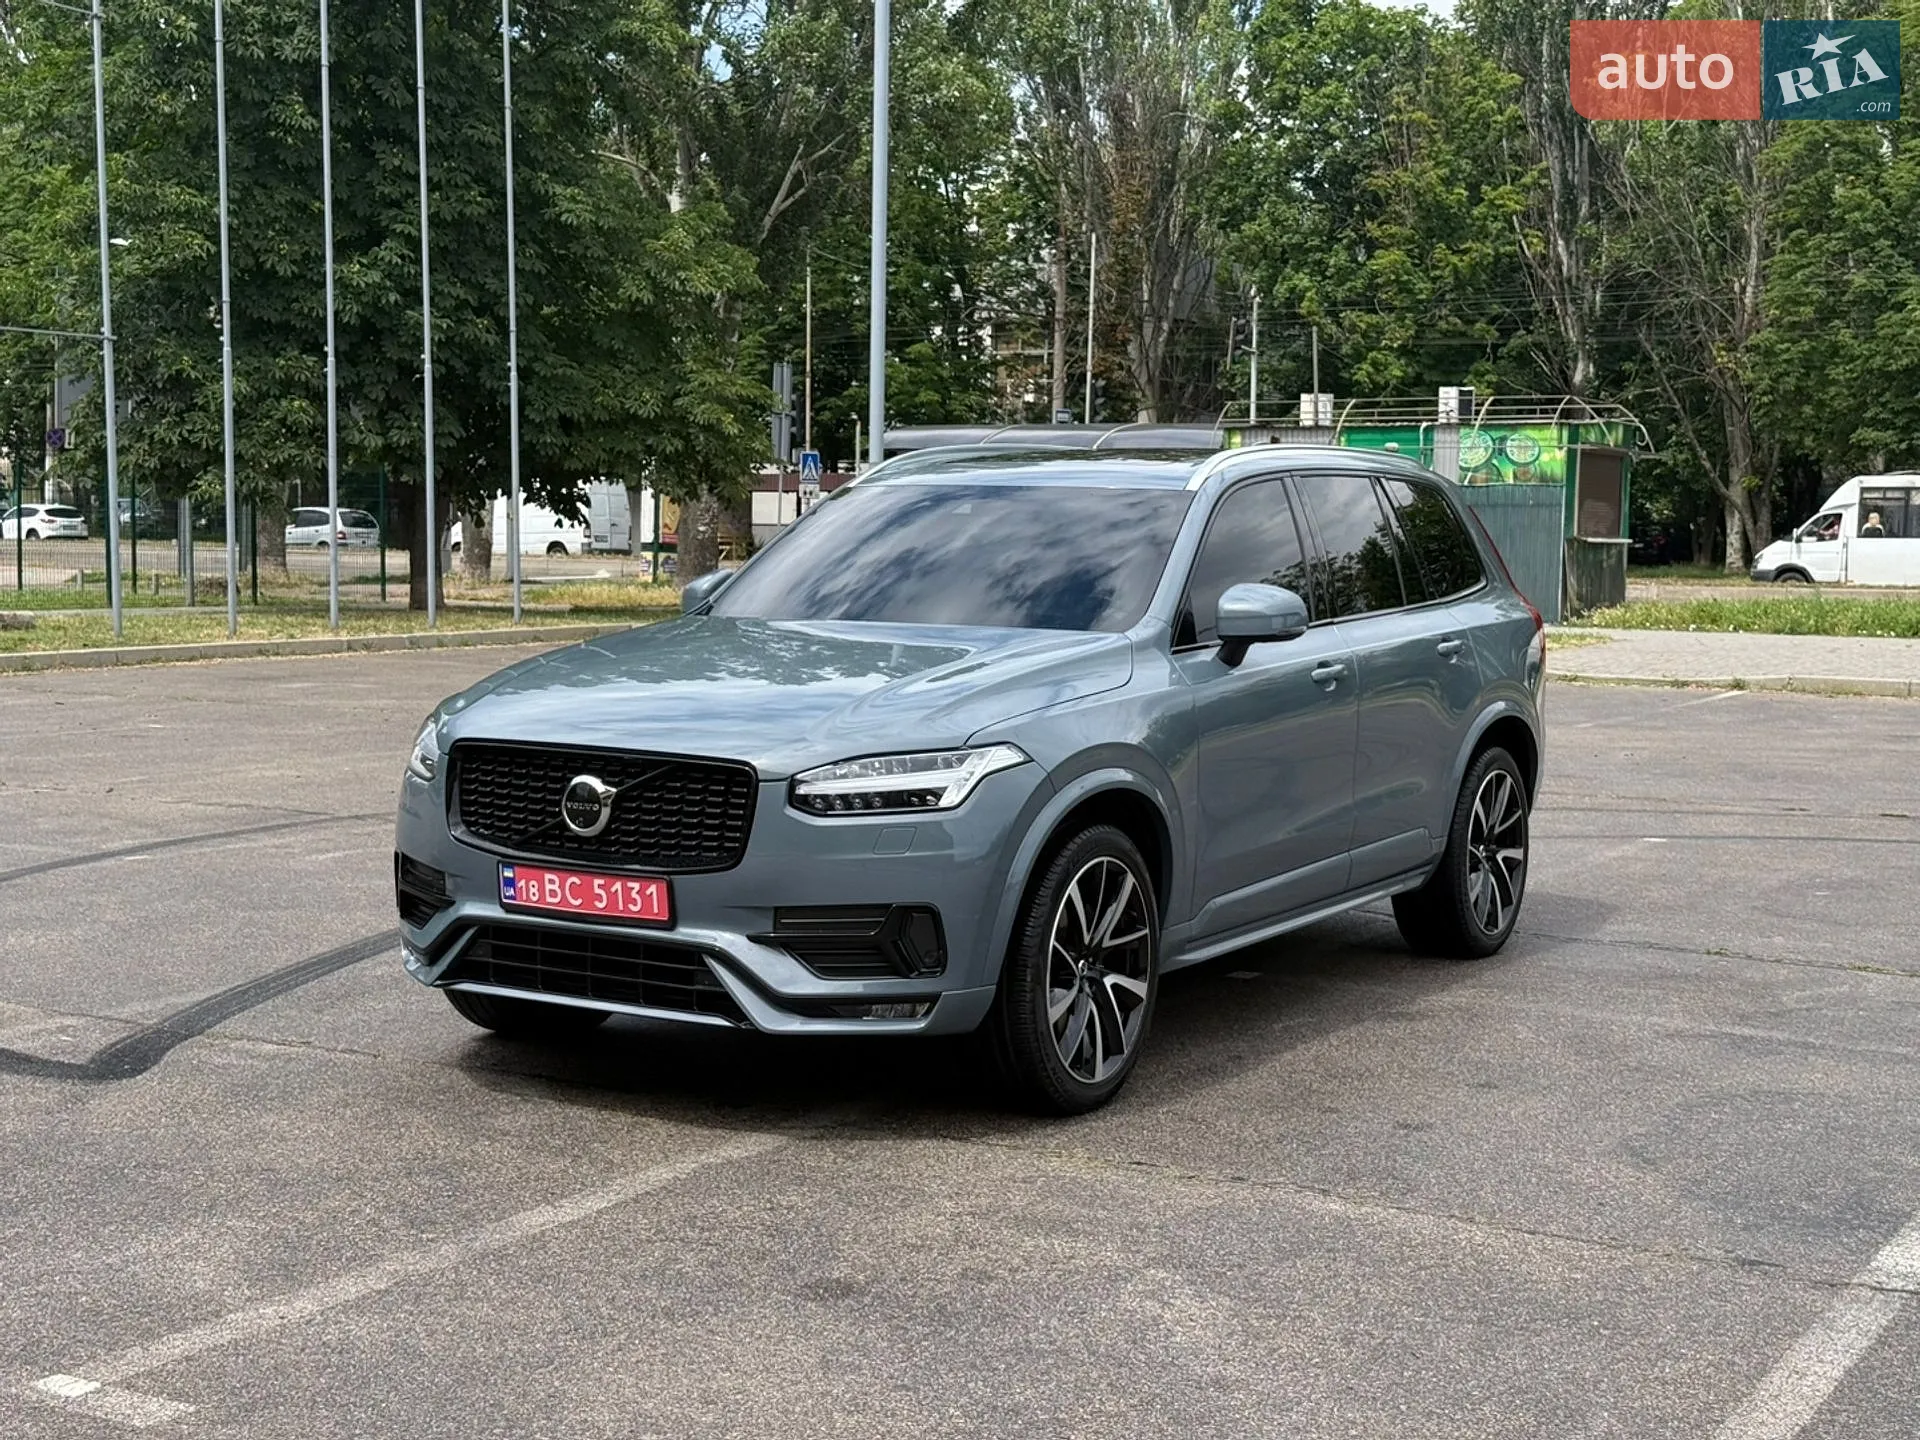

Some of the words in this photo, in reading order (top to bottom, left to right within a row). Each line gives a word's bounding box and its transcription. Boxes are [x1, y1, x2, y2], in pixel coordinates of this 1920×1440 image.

[566, 801, 600, 811] VOLVO
[504, 887, 516, 897] UA
[593, 879, 660, 914] 5131
